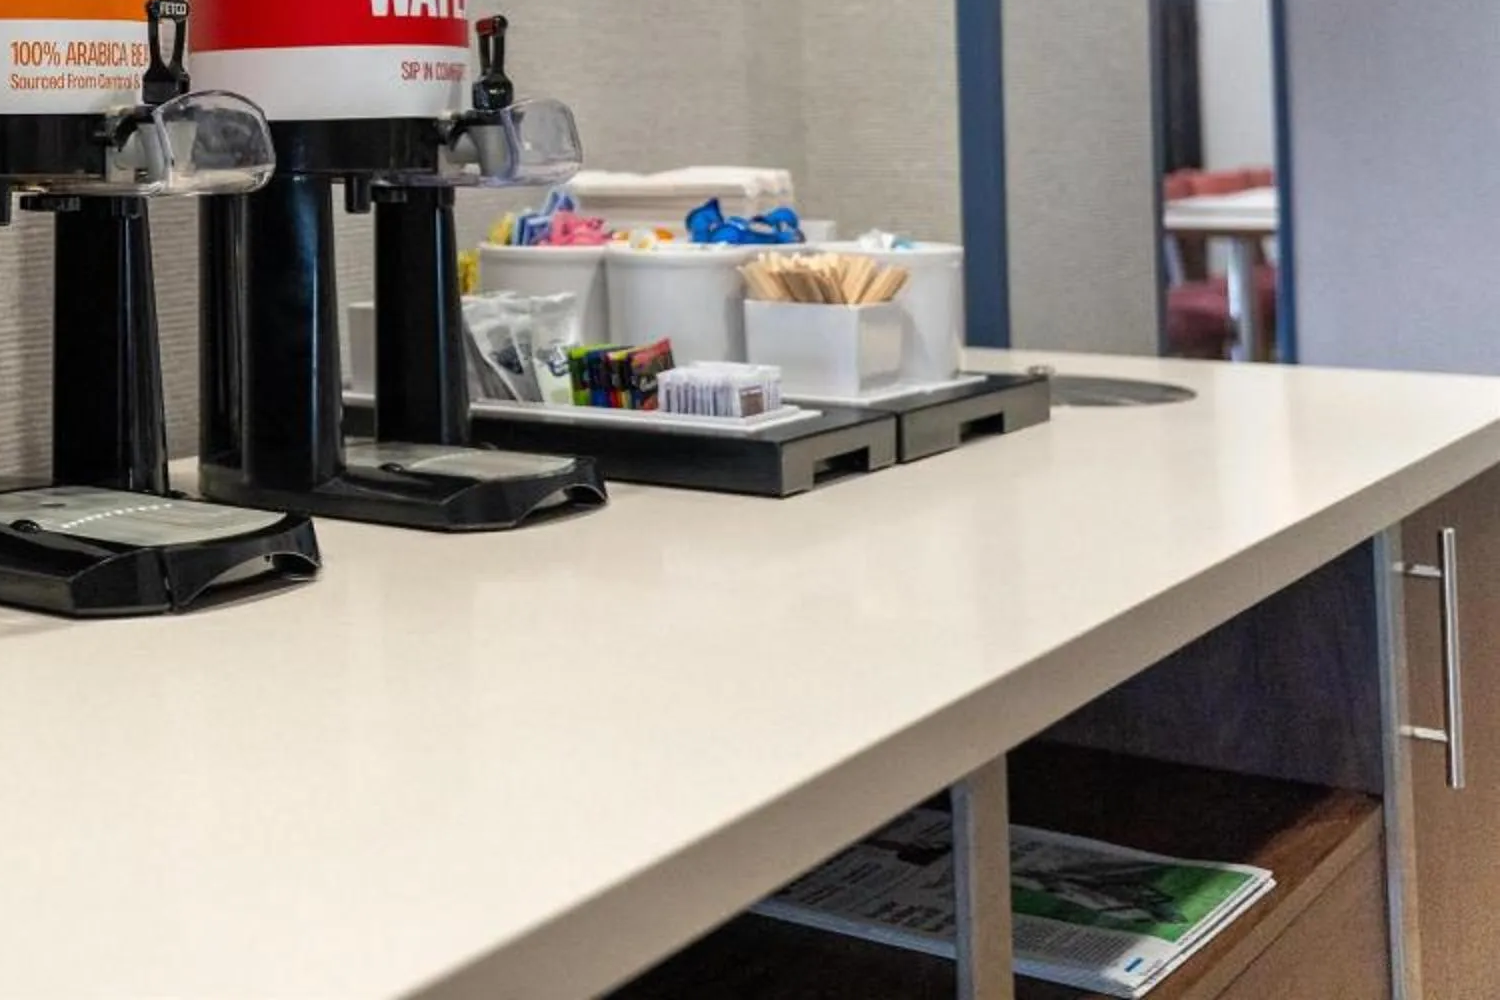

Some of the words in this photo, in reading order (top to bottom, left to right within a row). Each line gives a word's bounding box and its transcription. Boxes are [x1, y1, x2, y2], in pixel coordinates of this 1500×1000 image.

[159, 1, 187, 16] FETCO
[11, 41, 61, 66] 100%
[65, 41, 128, 67] ARABICA
[131, 42, 150, 67] BEA
[401, 61, 420, 81] SIP
[11, 73, 64, 90] Sourced
[68, 73, 96, 90] From
